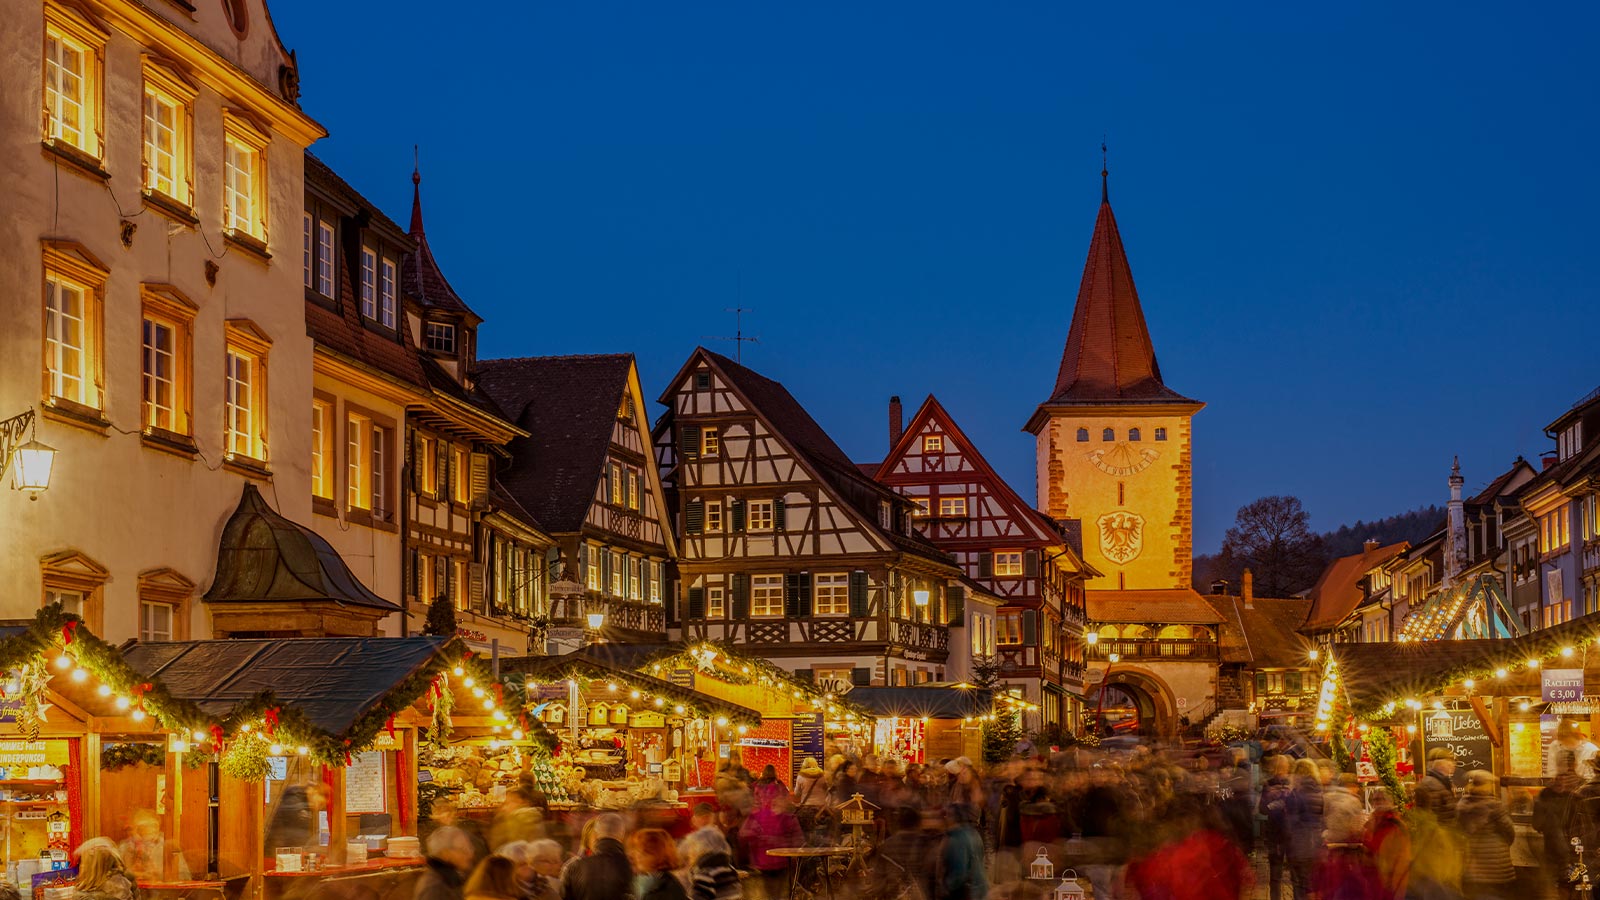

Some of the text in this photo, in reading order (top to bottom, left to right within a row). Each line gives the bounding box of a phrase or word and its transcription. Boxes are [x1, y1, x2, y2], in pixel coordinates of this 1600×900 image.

[820, 679, 845, 693] WC
[1545, 679, 1581, 687] RACLETTE
[1557, 690, 1576, 700] 3,00
[1453, 714, 1482, 731] Liebe
[0, 742, 24, 750] OMMES
